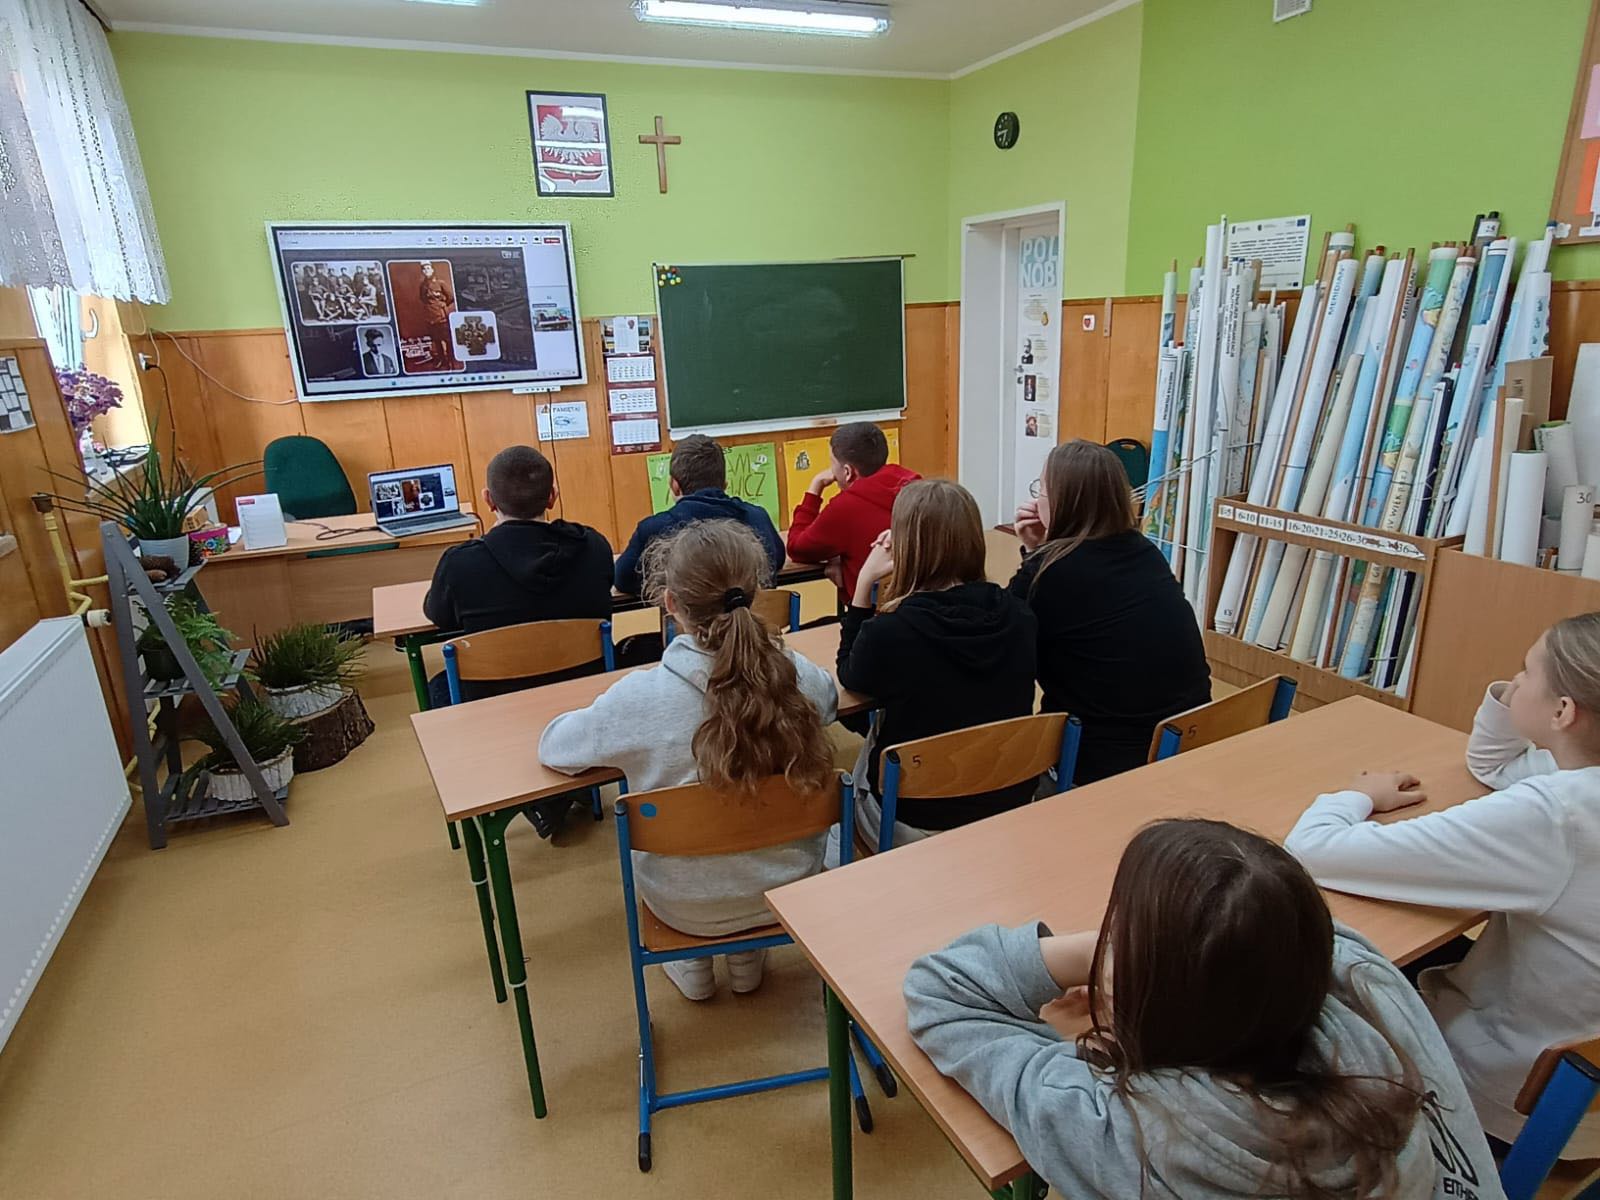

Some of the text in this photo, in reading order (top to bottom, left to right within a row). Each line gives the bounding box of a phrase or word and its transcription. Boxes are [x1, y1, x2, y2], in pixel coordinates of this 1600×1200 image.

[1023, 236, 1058, 263] POL
[1022, 261, 1056, 287] NOB
[1576, 491, 1593, 504] 30
[1238, 511, 1256, 522] 6-10
[1261, 516, 1283, 529] 11-15
[912, 755, 921, 768] 5
